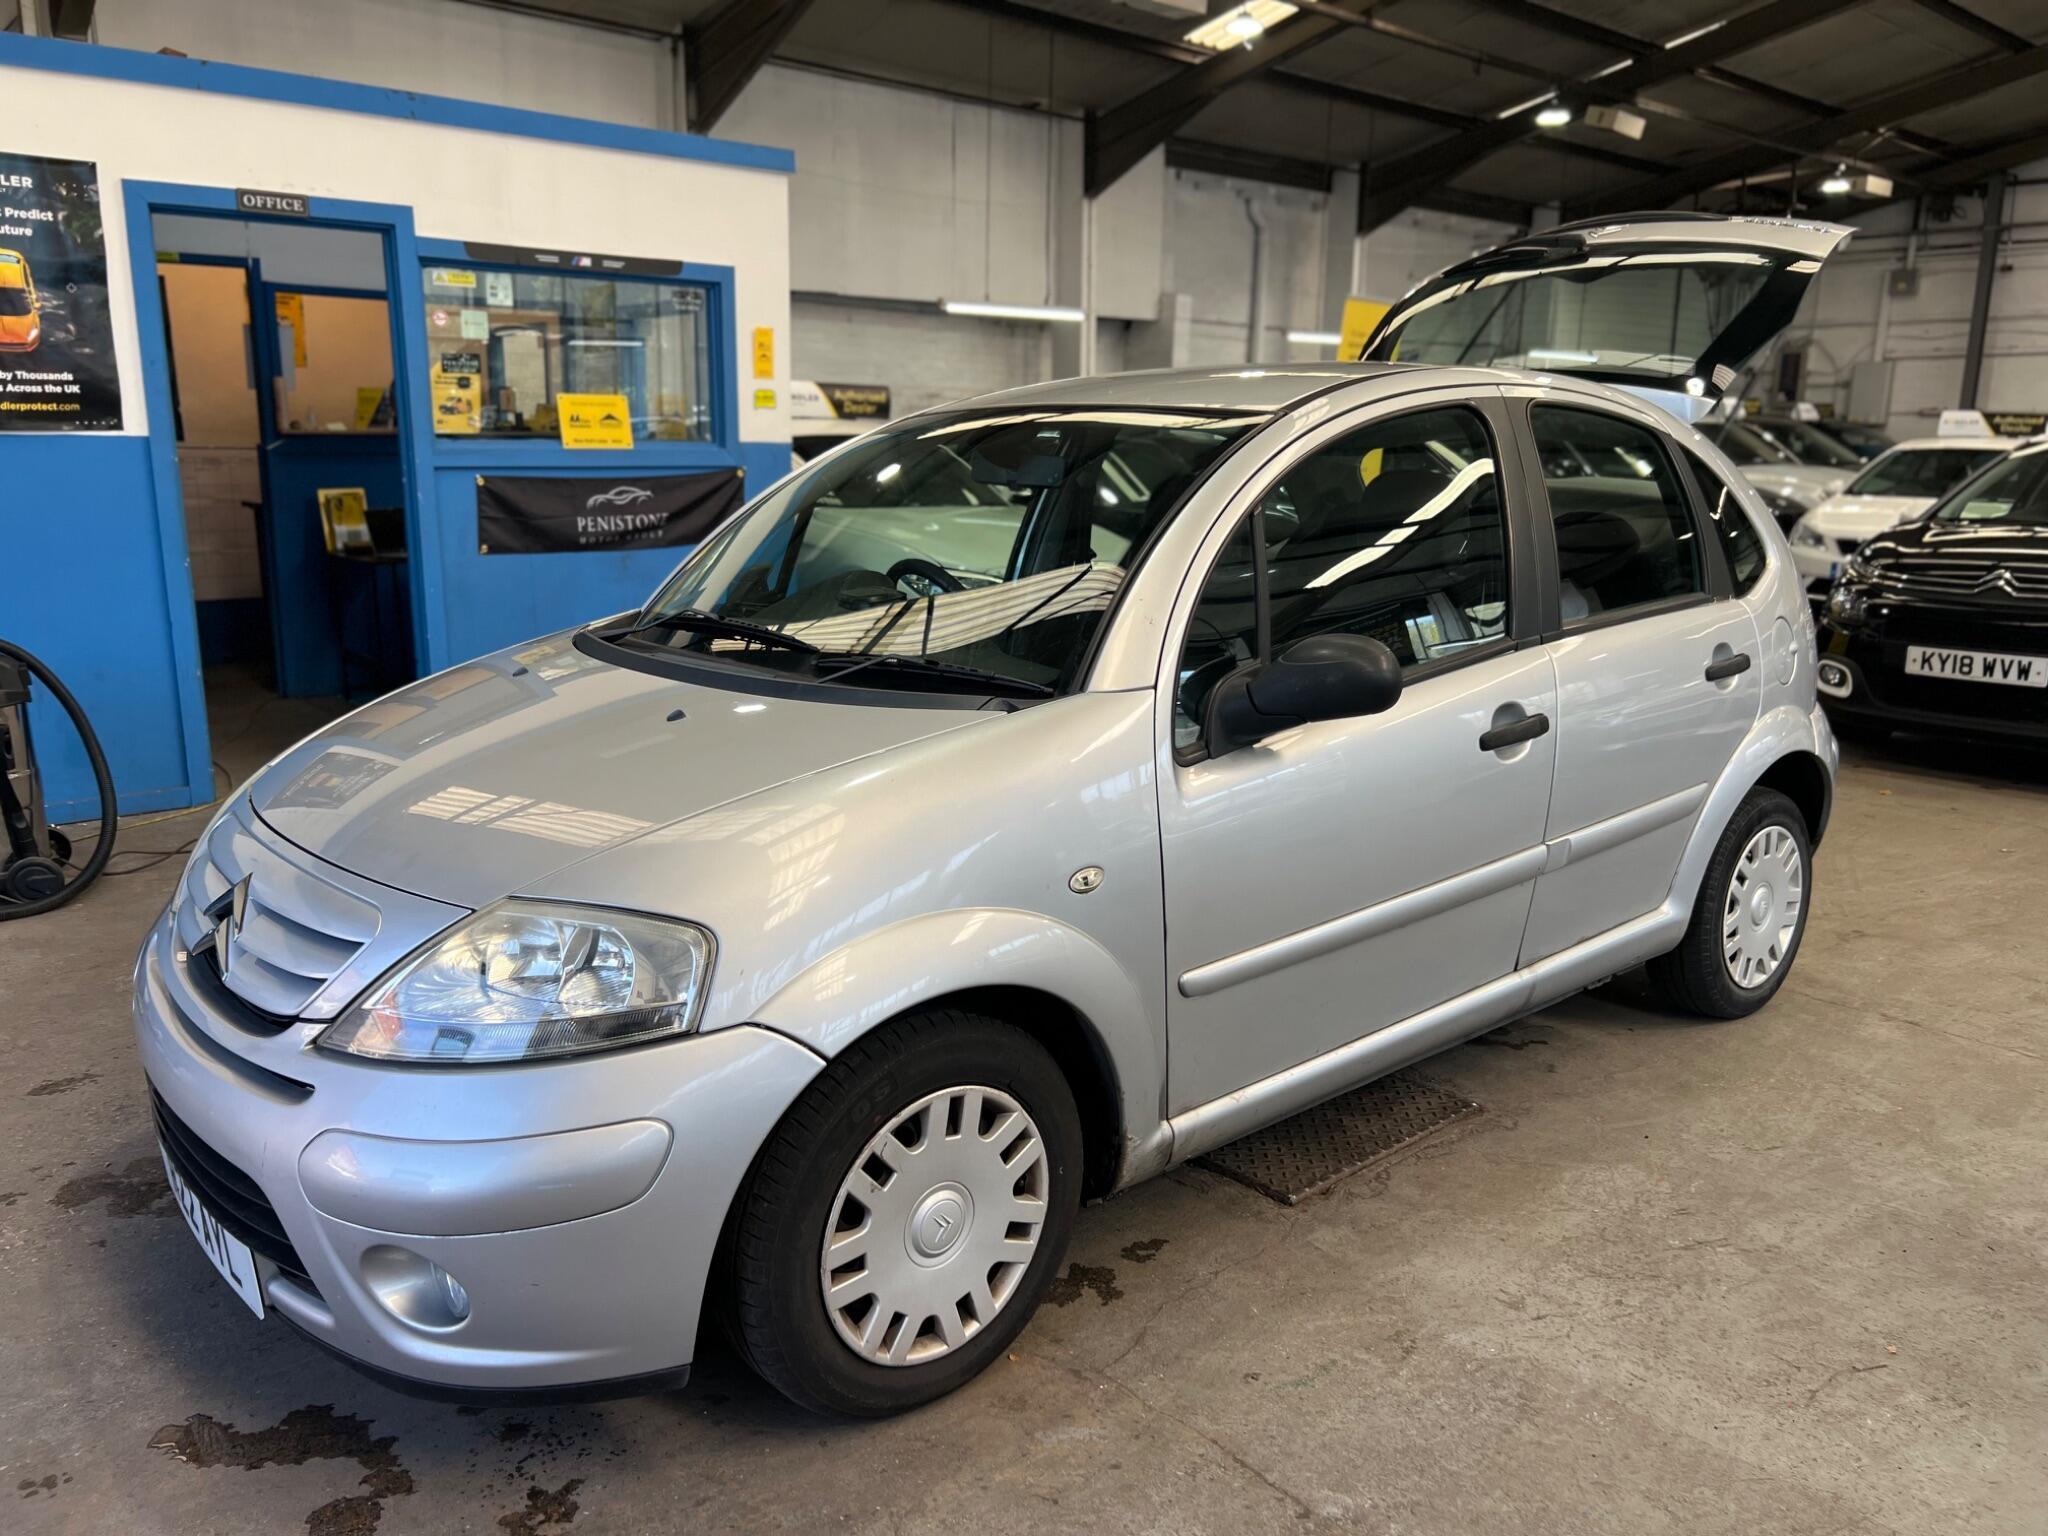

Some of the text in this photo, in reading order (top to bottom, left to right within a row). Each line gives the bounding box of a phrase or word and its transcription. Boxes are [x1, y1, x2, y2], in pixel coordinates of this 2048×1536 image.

[243, 194, 304, 211] OFFICE
[4, 207, 54, 221] Predict
[14, 371, 74, 381] Thousands
[6, 384, 43, 393] Across
[44, 384, 62, 393] the
[64, 385, 81, 394] UK
[0, 402, 81, 412] dlerprotect.com
[1921, 650, 2032, 681] KY18 WVW
